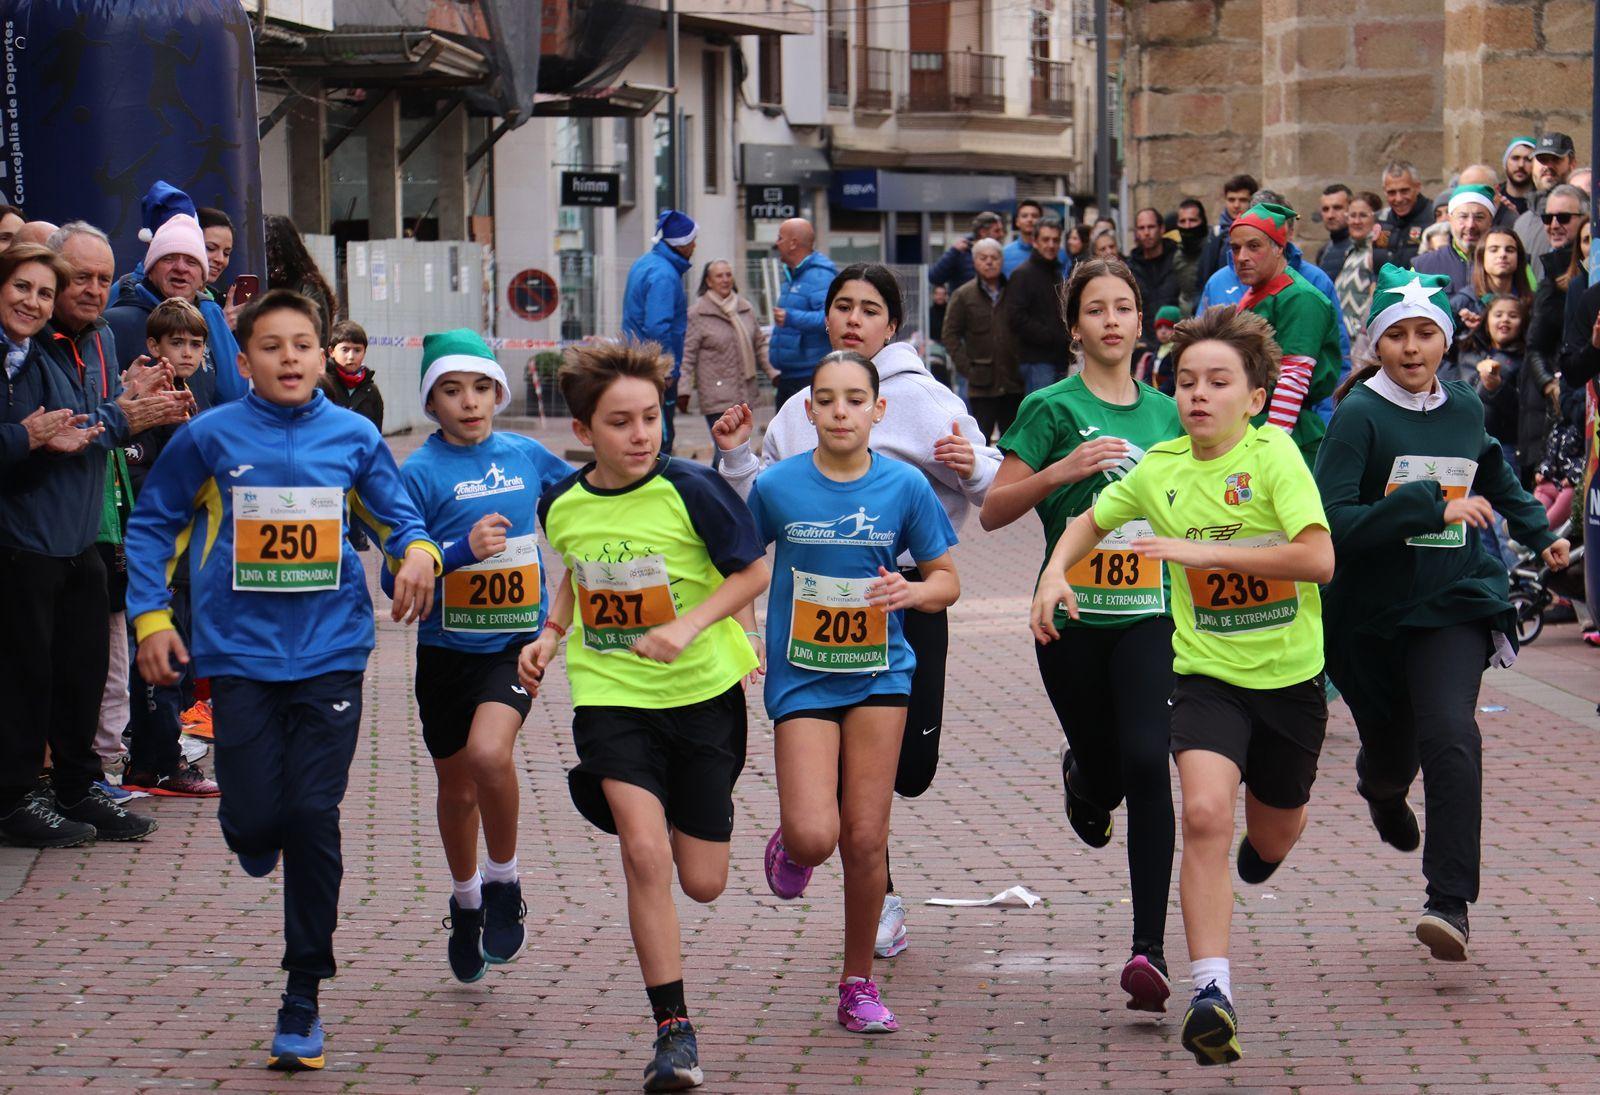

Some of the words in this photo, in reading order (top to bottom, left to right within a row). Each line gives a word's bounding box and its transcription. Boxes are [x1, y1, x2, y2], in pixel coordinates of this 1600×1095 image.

[5, 21, 17, 95] Deportes
[7, 98, 18, 119] de
[572, 177, 609, 192] himm
[260, 523, 317, 560] 250
[240, 569, 262, 582] JUNTA
[267, 570, 277, 582] DE
[281, 568, 334, 581] EXTREMADURA
[1090, 552, 1140, 586] 183
[469, 570, 525, 606] 208
[1207, 573, 1269, 607] 236
[590, 592, 643, 626] 237
[1093, 594, 1103, 605] DE
[1106, 594, 1159, 605] EXTREMADURA
[449, 612, 472, 624] JUNTA
[476, 614, 486, 625] DE
[813, 609, 868, 643] 203
[1220, 615, 1232, 627] DE
[1235, 605, 1296, 625] EXTREMADURA
[605, 633, 618, 644] DE
[793, 645, 814, 661] JUNTA
[817, 650, 828, 663] DE
[830, 649, 883, 664] EXTREMADURA
